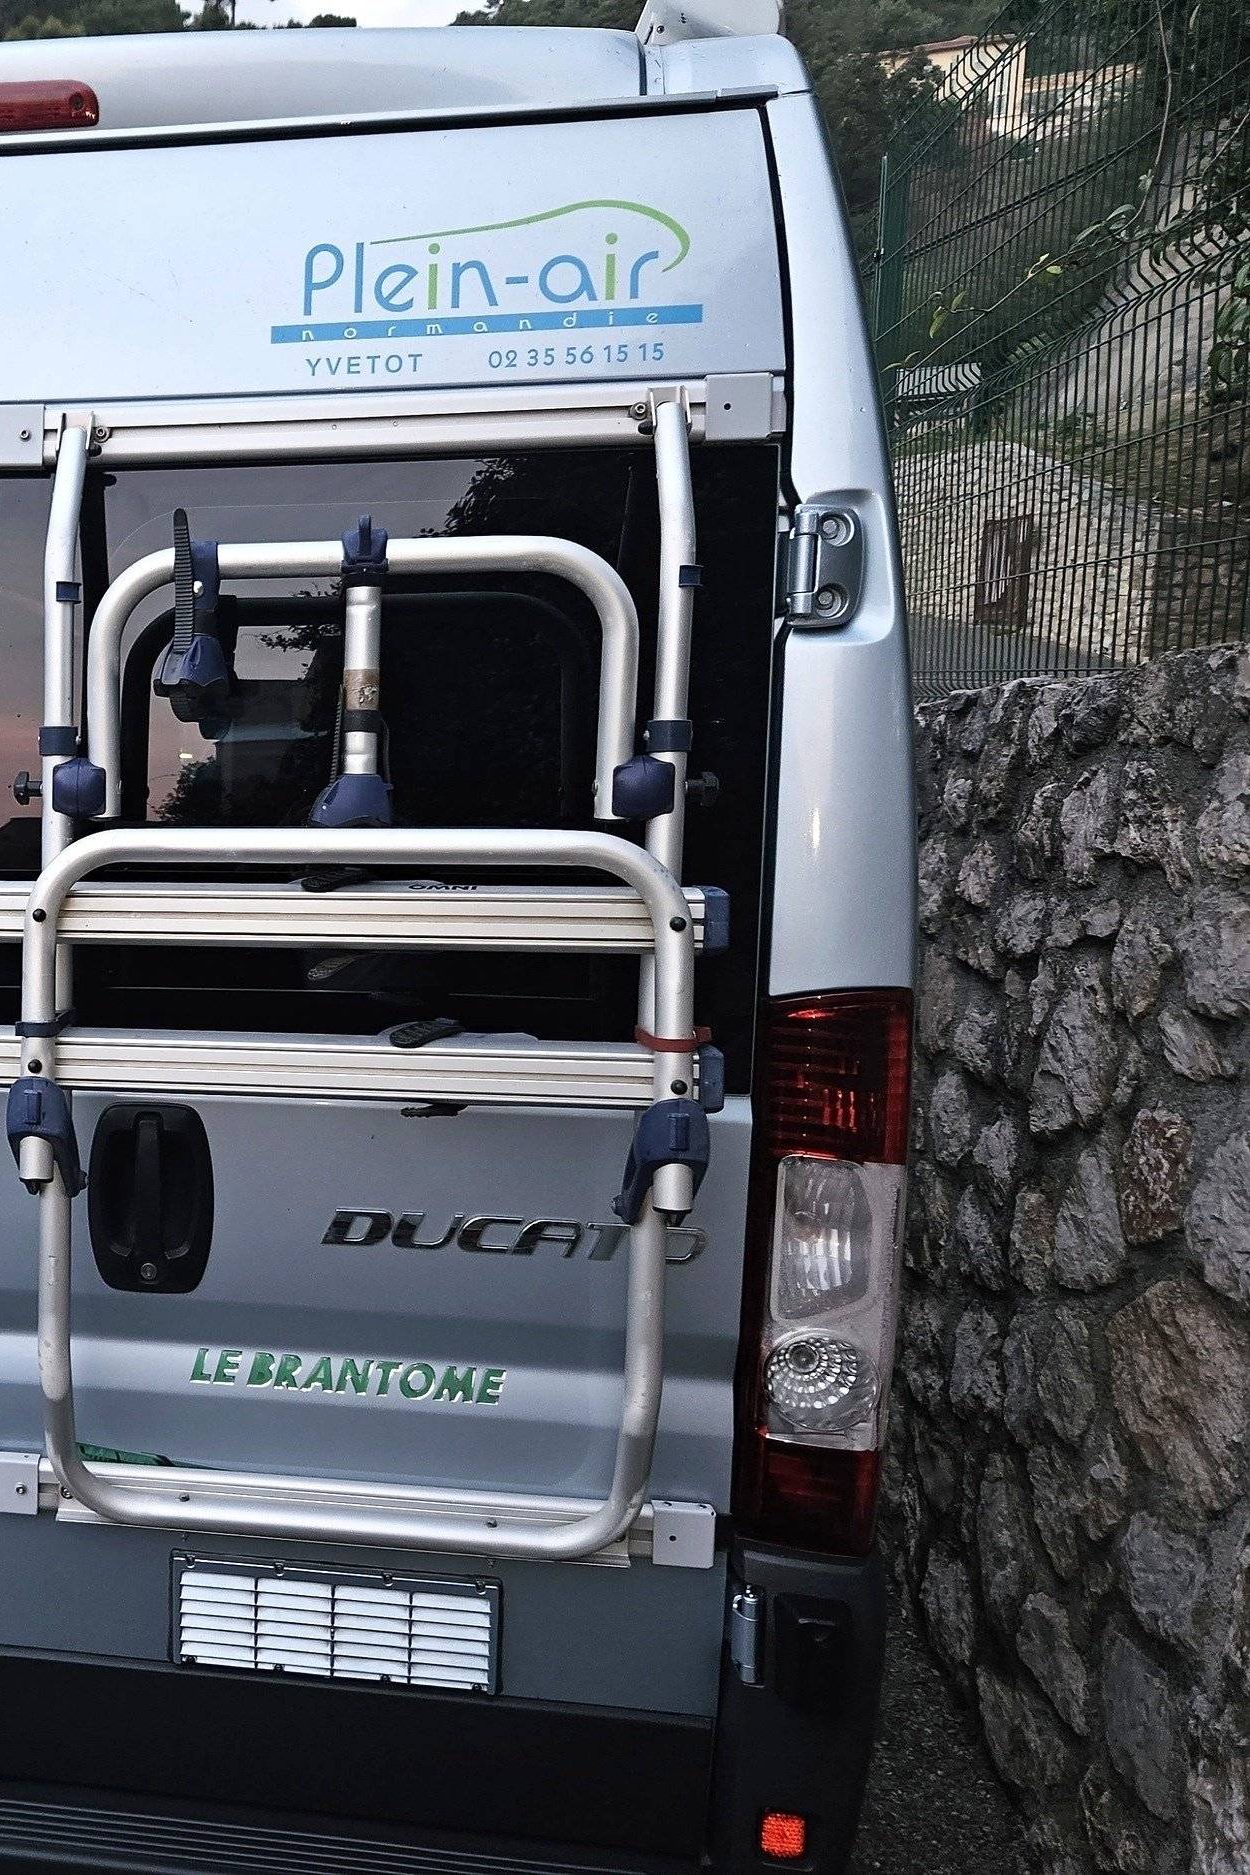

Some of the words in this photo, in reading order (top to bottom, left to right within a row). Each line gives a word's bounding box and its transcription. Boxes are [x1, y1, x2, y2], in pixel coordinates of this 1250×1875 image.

[303, 232, 659, 316] Plein-air
[301, 311, 658, 341] normandie
[306, 354, 423, 377] YVETOT
[488, 350, 517, 369] 02
[527, 348, 556, 367] 35
[565, 346, 594, 365] 56
[604, 344, 629, 363] 15
[638, 342, 665, 361] 15
[190, 1348, 242, 1385] LE
[247, 1352, 507, 1406] BRANTOME
